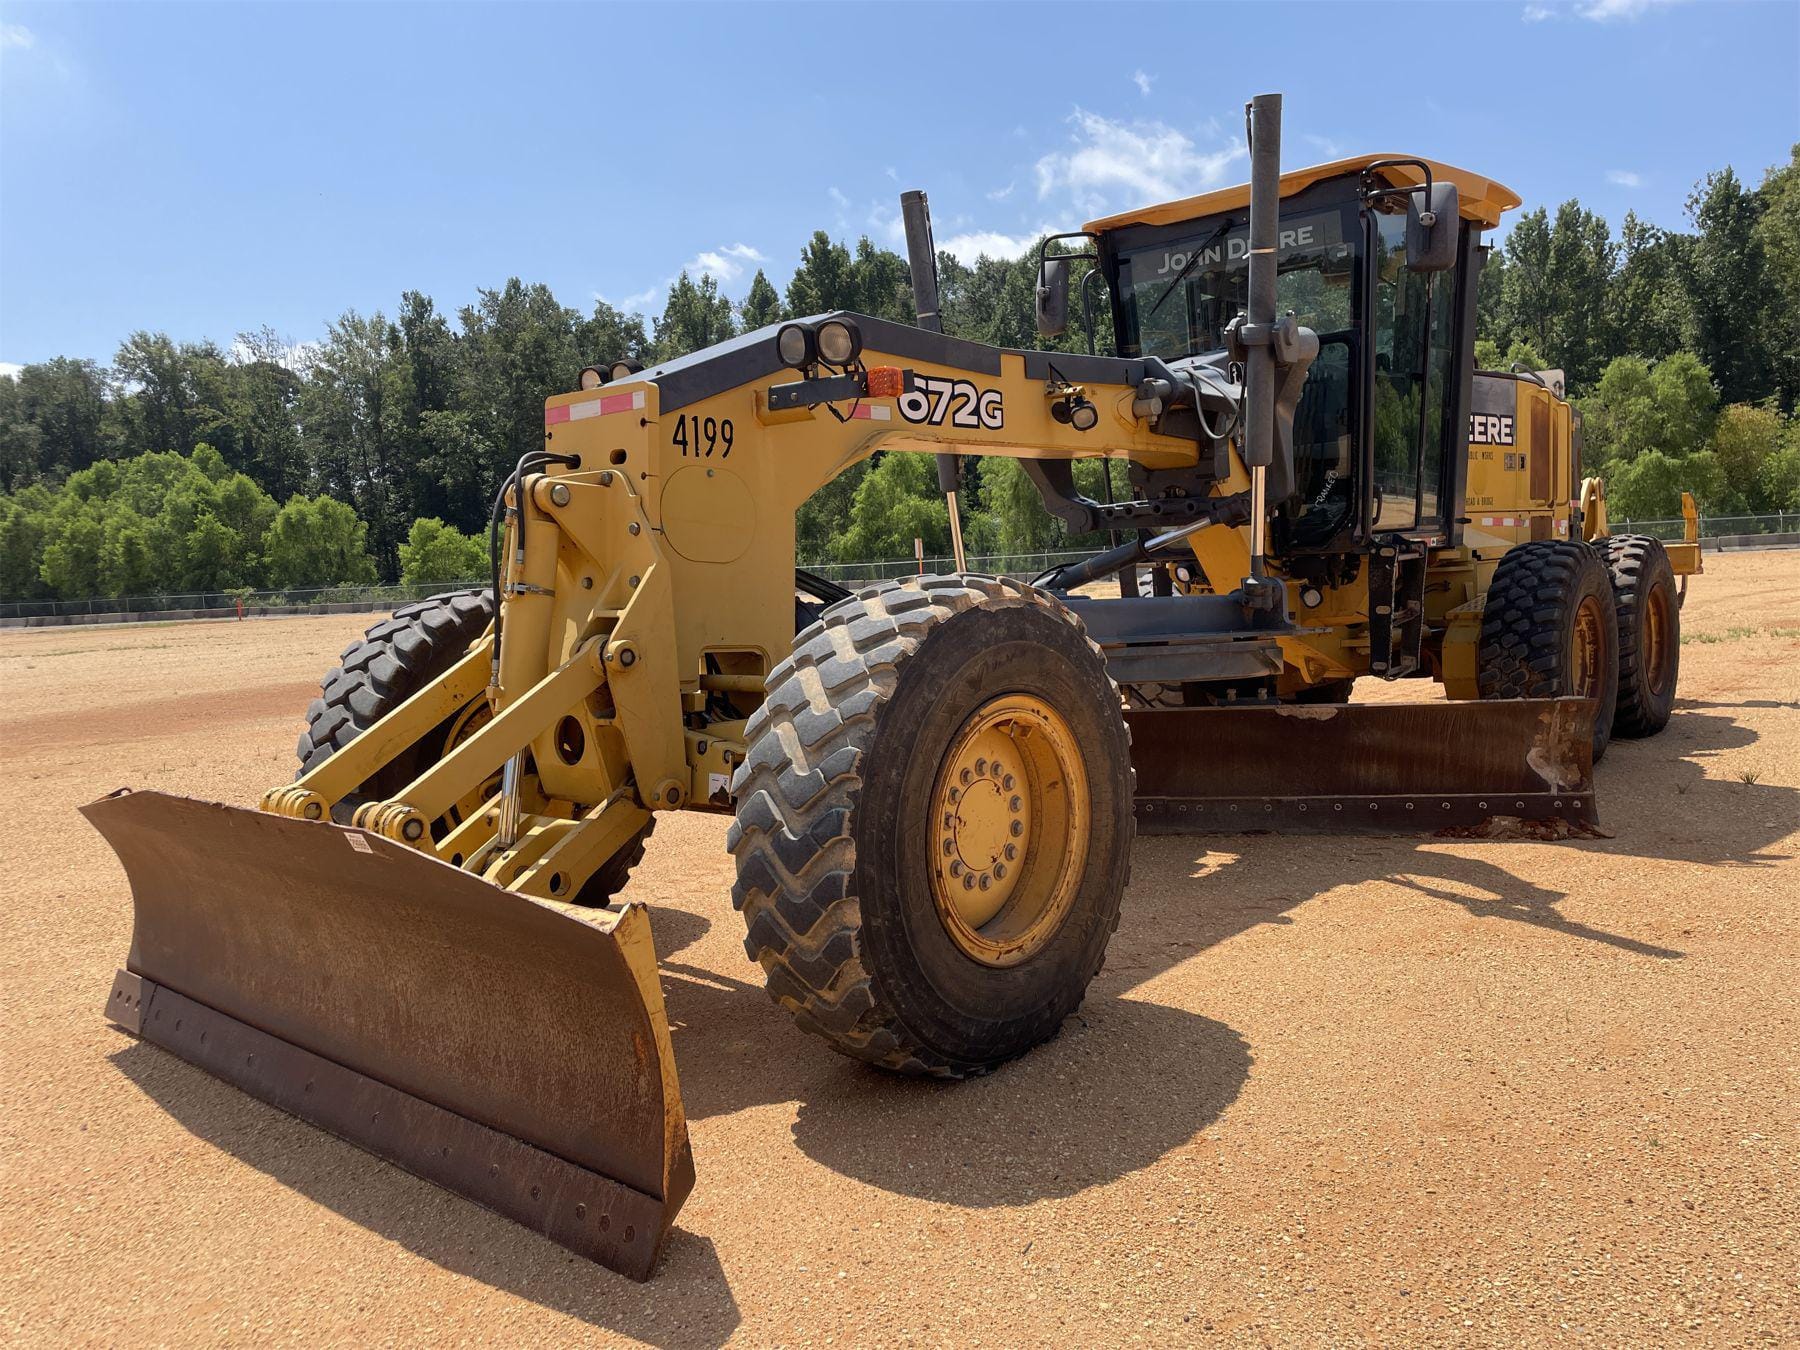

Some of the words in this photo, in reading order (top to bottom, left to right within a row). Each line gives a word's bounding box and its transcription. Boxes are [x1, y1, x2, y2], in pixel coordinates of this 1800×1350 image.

[1227, 225, 1314, 260] DRE
[898, 373, 1003, 430] 672G
[672, 414, 734, 459] 4199
